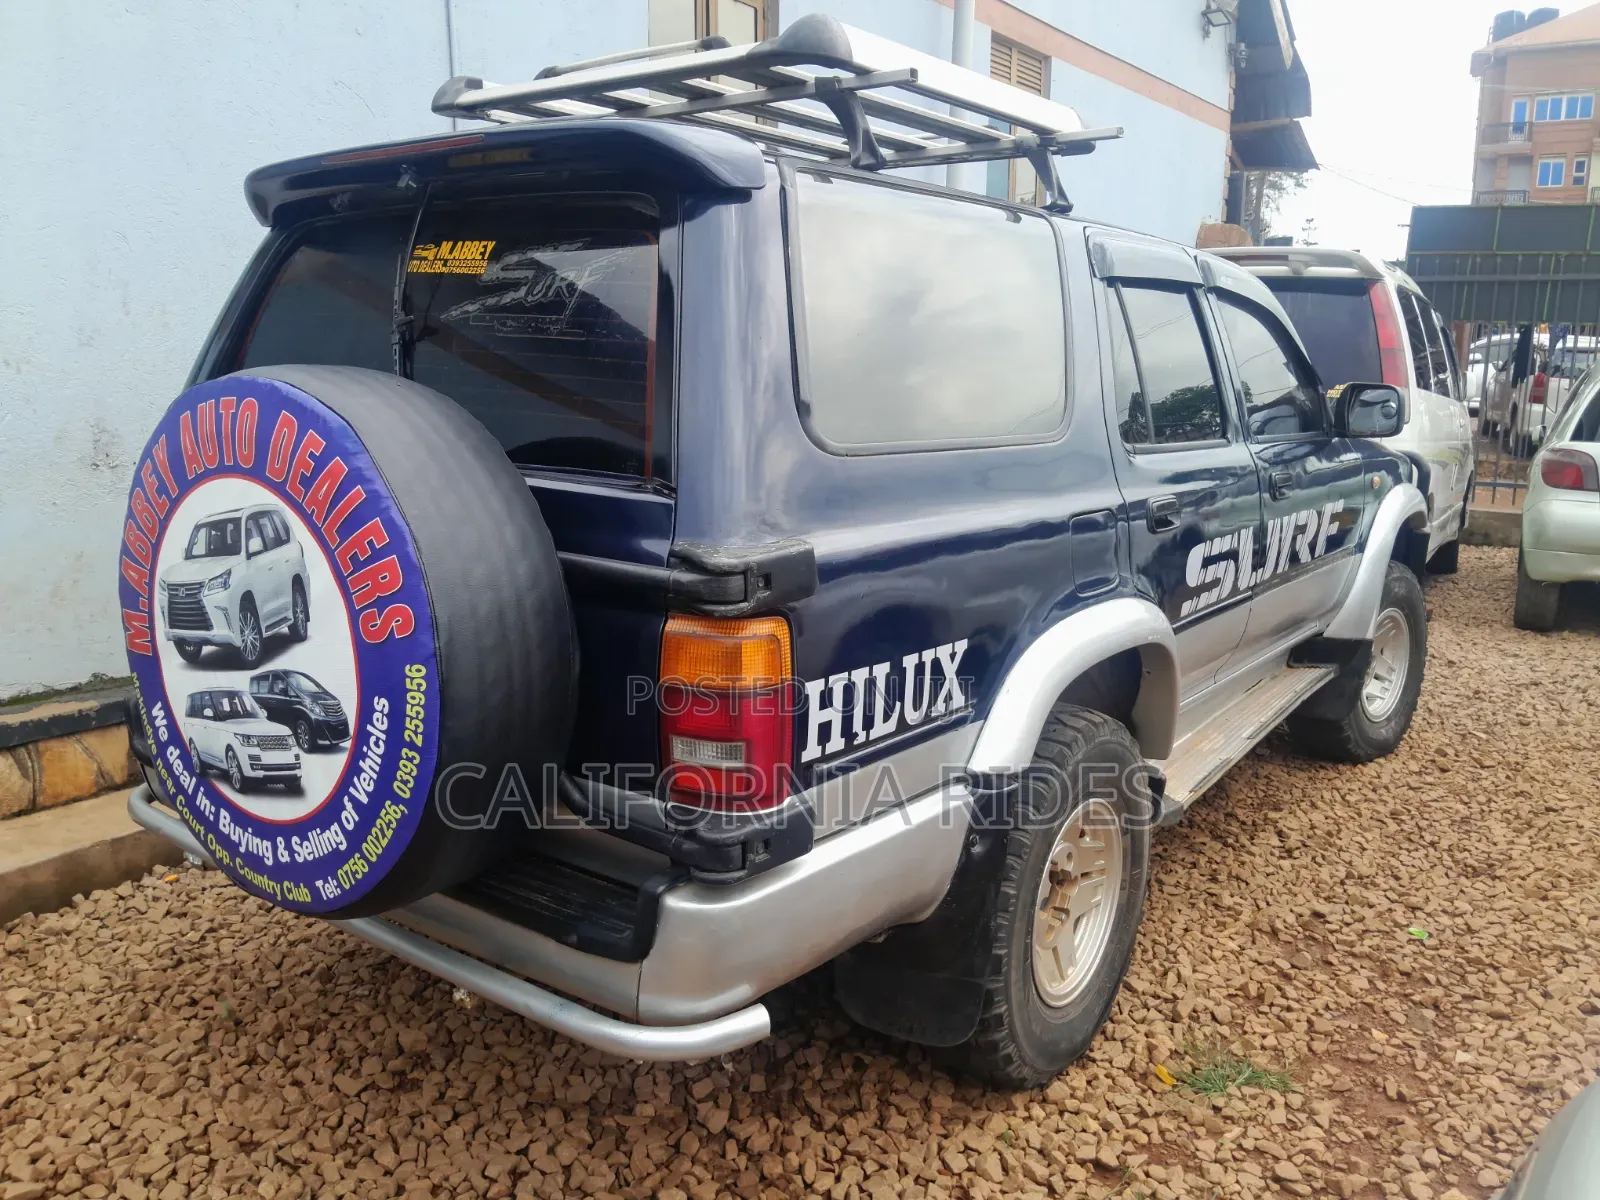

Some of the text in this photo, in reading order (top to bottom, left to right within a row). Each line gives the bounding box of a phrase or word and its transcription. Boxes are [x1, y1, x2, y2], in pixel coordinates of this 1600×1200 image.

[407, 260, 444, 274] UTO DEALERS
[436, 240, 497, 260] M.ABBEY
[121, 396, 415, 656] M.ABBEY AUTO DEALERS
[1179, 498, 1345, 618] SURF
[800, 638, 969, 764] HILUX
[131, 671, 312, 902] Makindye near Court Opp. Country Club
[151, 695, 390, 867] We deal in: Buying & Selling of Vehicles
[315, 663, 428, 901] Tel: 0756 002256, 0393 255956
